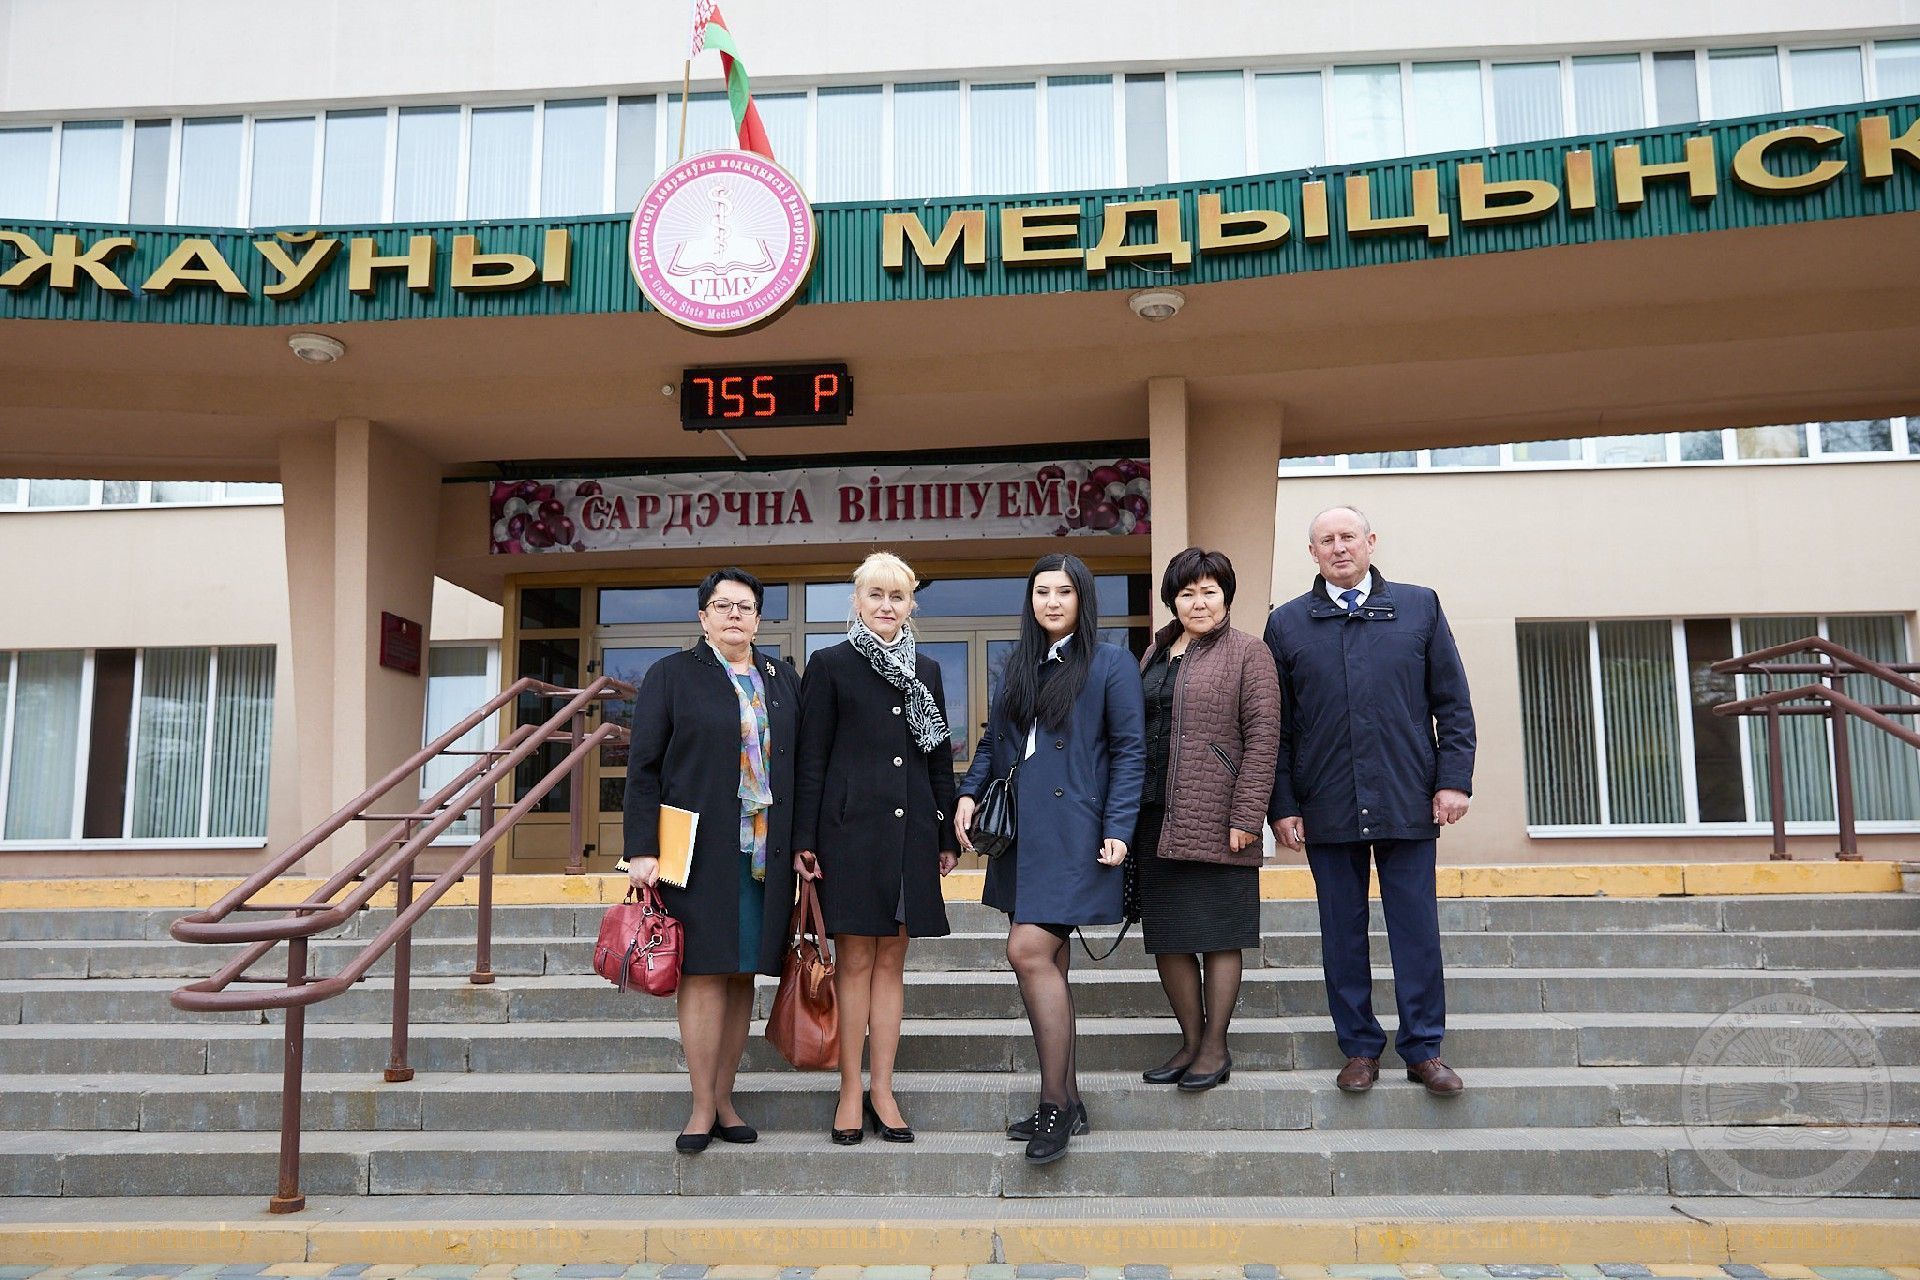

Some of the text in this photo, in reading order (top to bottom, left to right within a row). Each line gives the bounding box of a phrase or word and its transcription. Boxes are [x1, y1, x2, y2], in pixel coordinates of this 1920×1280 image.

[0, 115, 1920, 299] ЖАЎНЫ МЕДЫЦЫНСК
[689, 276, 758, 301] ГДМУ
[747, 275, 790, 312] University
[693, 375, 776, 417] 755
[582, 488, 813, 536] САРДЭЧНА
